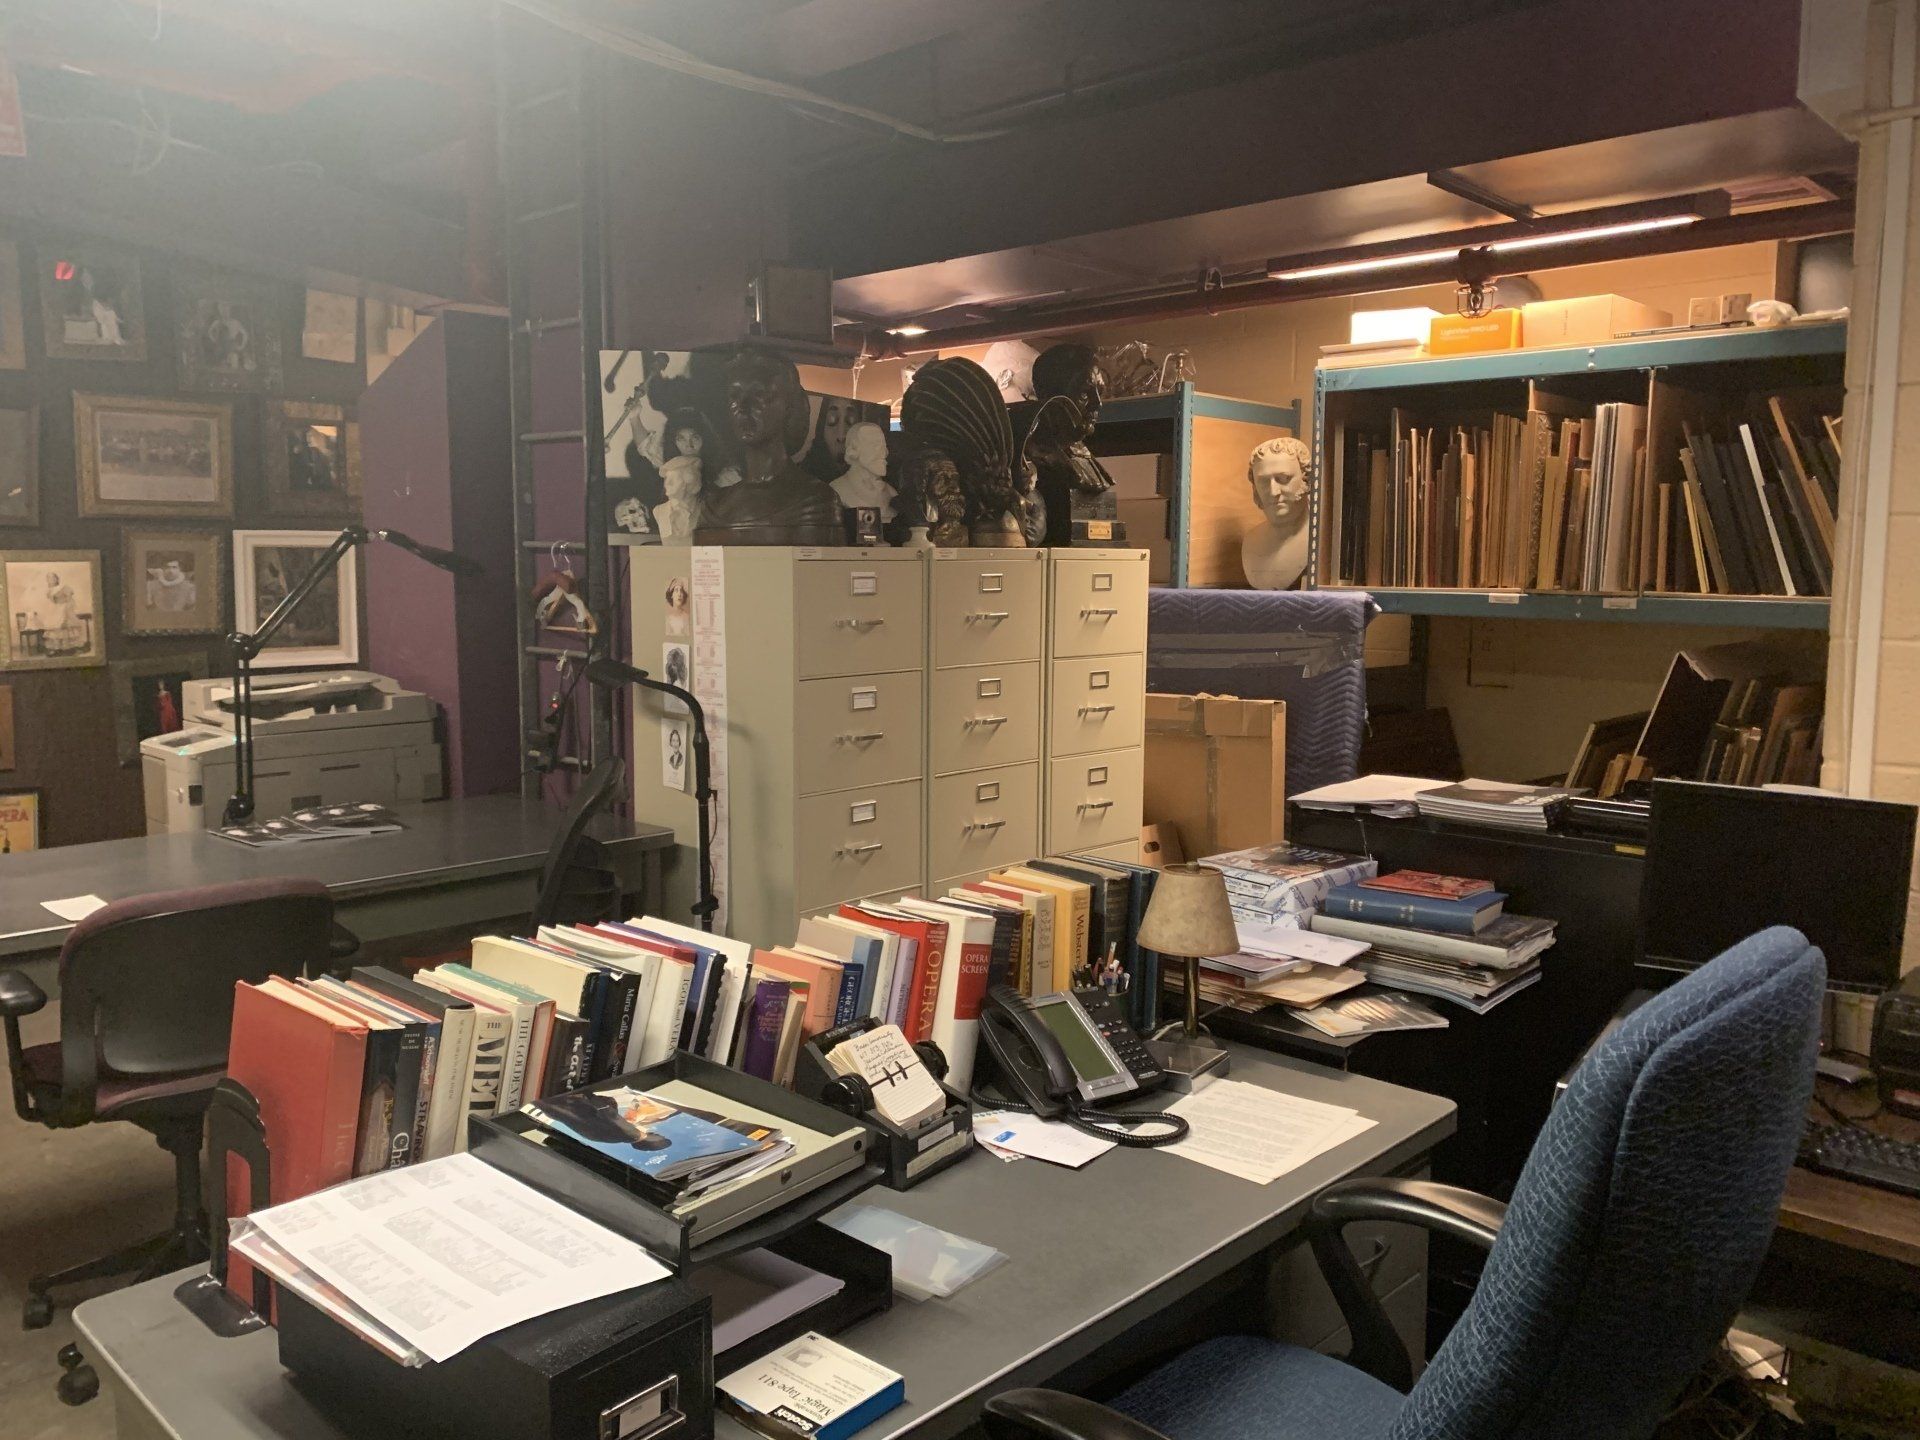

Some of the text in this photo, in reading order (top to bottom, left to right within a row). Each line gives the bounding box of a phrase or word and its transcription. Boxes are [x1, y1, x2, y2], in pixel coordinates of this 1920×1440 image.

[961, 964, 988, 974] SCREEN
[965, 953, 988, 963] OPERA
[624, 988, 635, 1012] Maria
[679, 978, 690, 1008] IGOR
[919, 951, 942, 1032] OPERA
[518, 1020, 530, 1039] THE
[618, 1013, 630, 1040] Callas
[669, 1023, 681, 1051] VERA
[571, 1035, 583, 1053] the
[510, 1043, 527, 1095] GOLDEN
[568, 1054, 580, 1078] art
[757, 1373, 780, 1390] 811
[777, 1381, 801, 1403] Tape
[801, 1397, 835, 1418] Magic
[774, 1407, 815, 1433] Scotch
